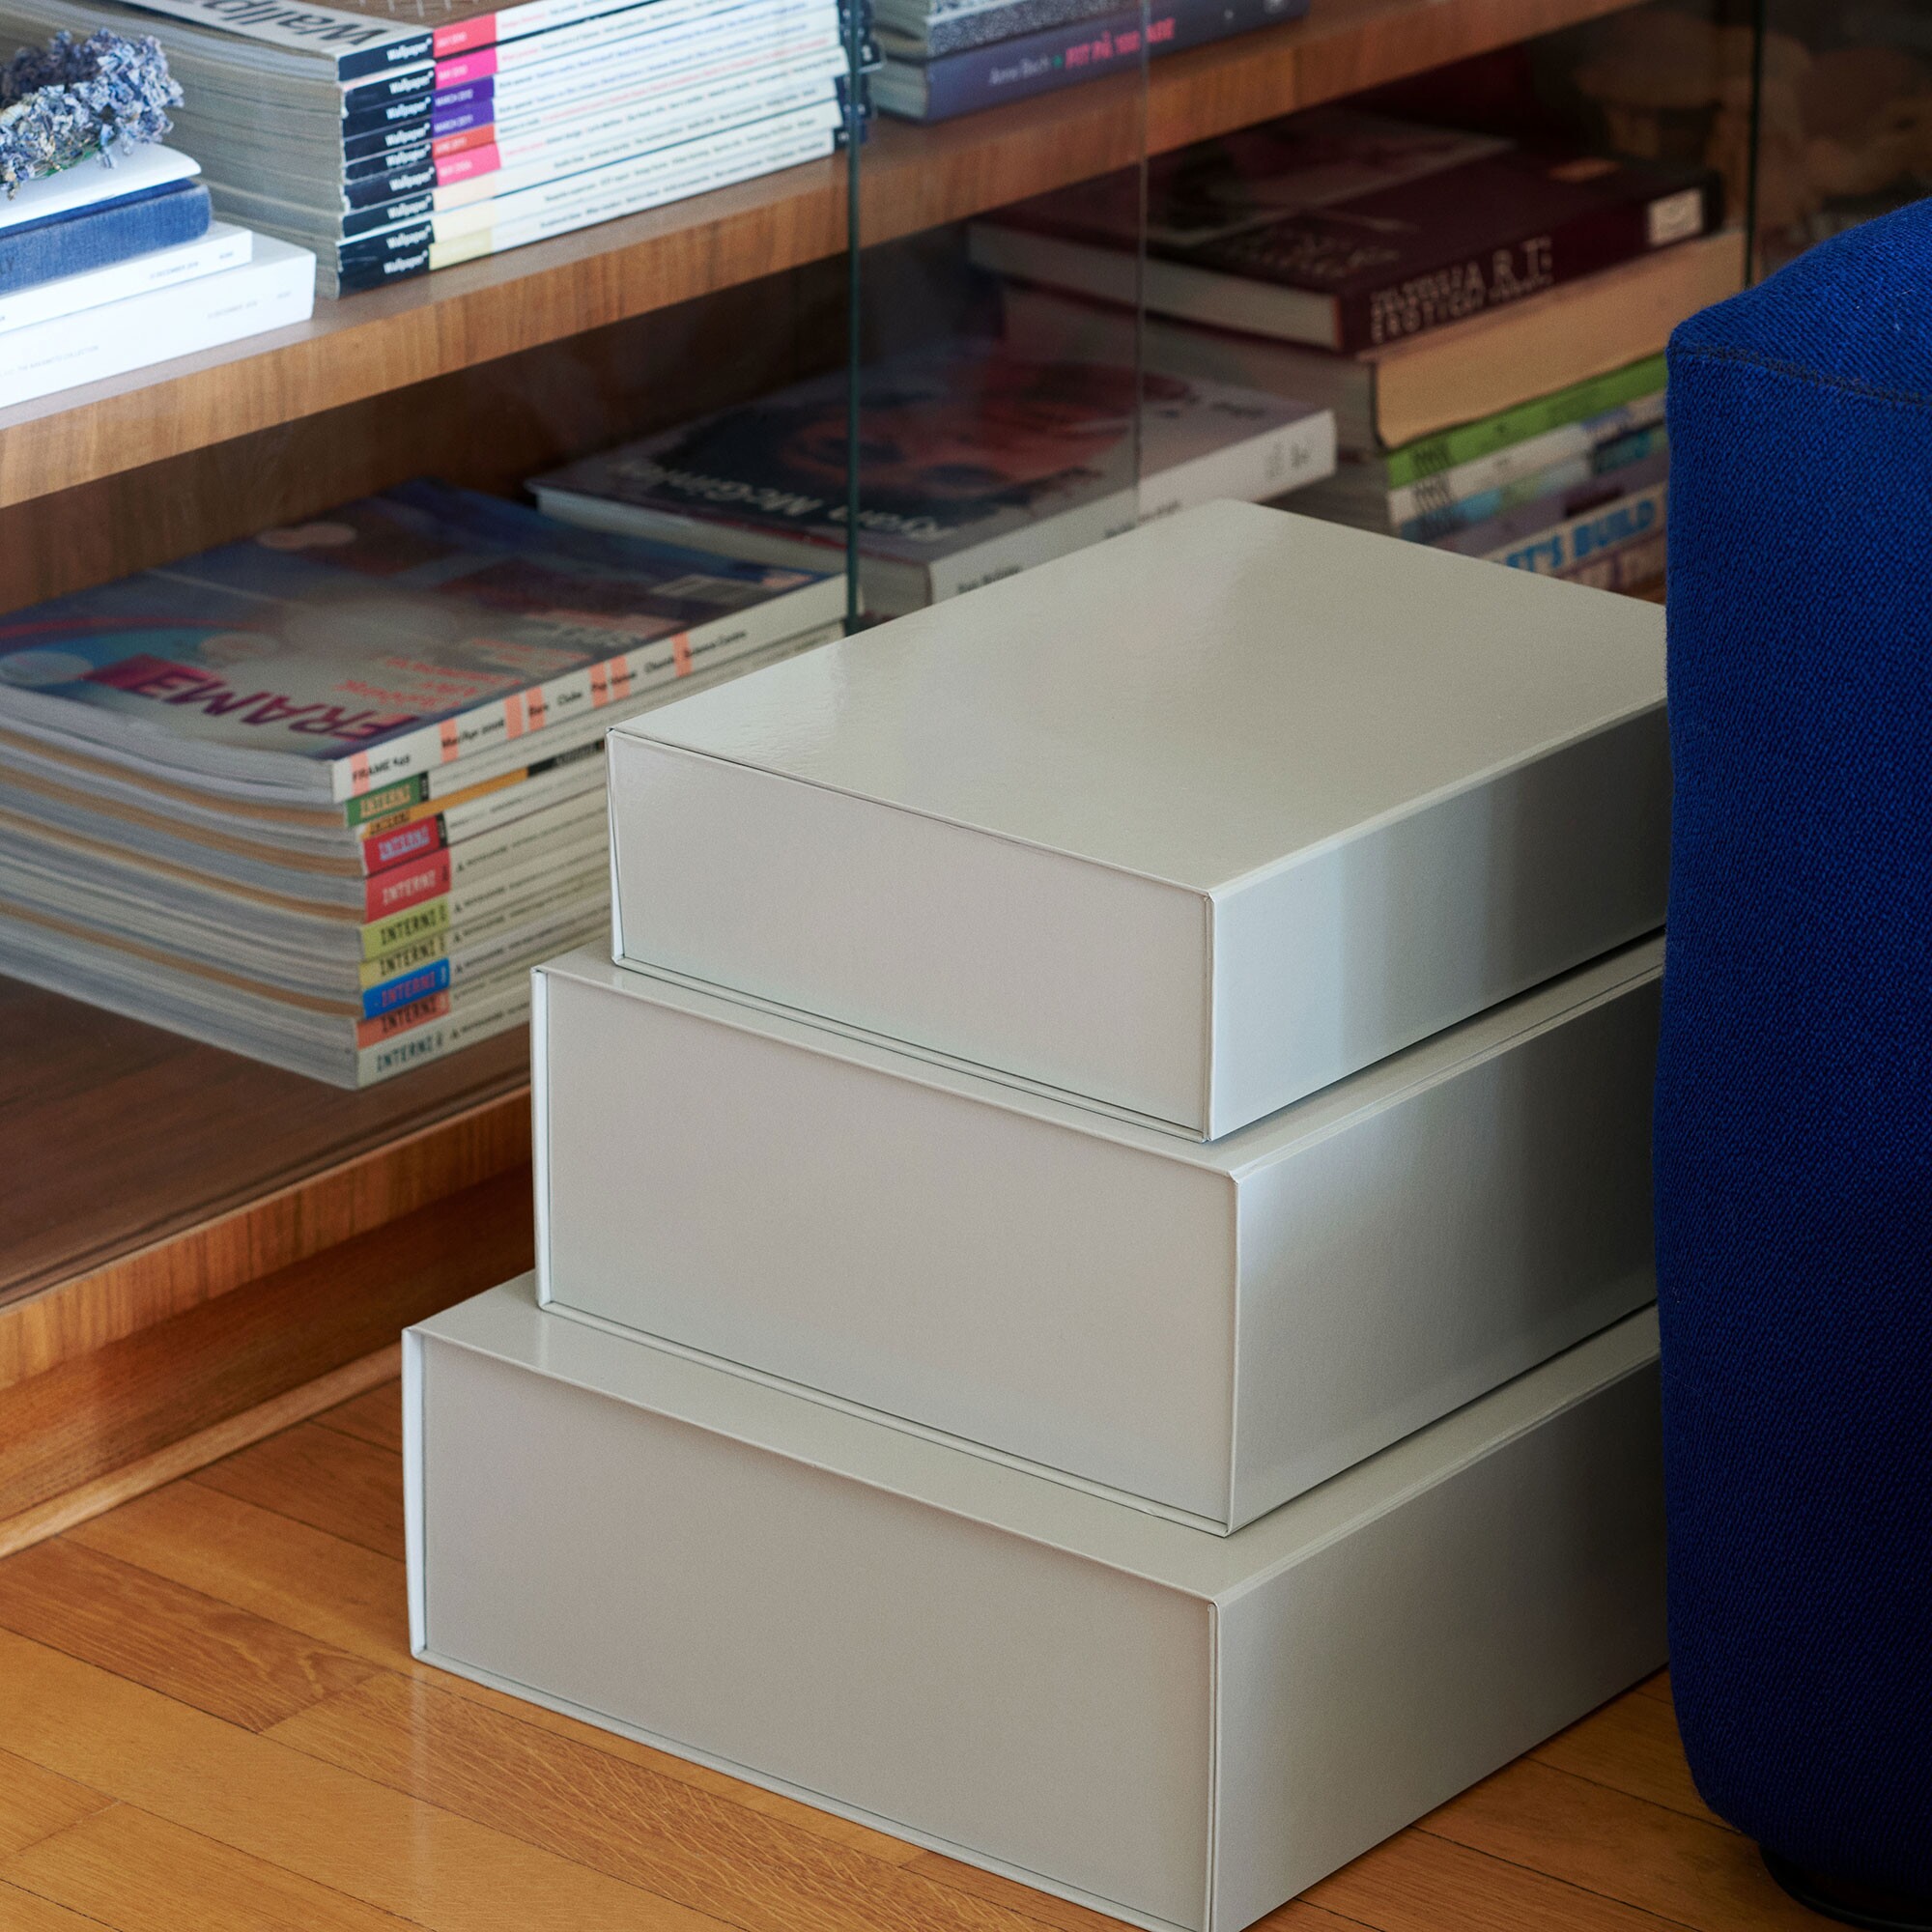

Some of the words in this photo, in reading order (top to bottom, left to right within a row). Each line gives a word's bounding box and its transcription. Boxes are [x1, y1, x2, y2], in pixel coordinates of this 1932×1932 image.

[1574, 498, 1656, 559] BUILD
[133, 670, 419, 742] FRAME
[353, 759, 389, 782] FRAME
[383, 869, 436, 906] INTERNI
[381, 909, 435, 945] INTERNI
[380, 938, 435, 977] INTERNI
[382, 971, 435, 1008] INTERNI
[382, 994, 437, 1034] INTERNI
[377, 1036, 432, 1072] INTERNI
